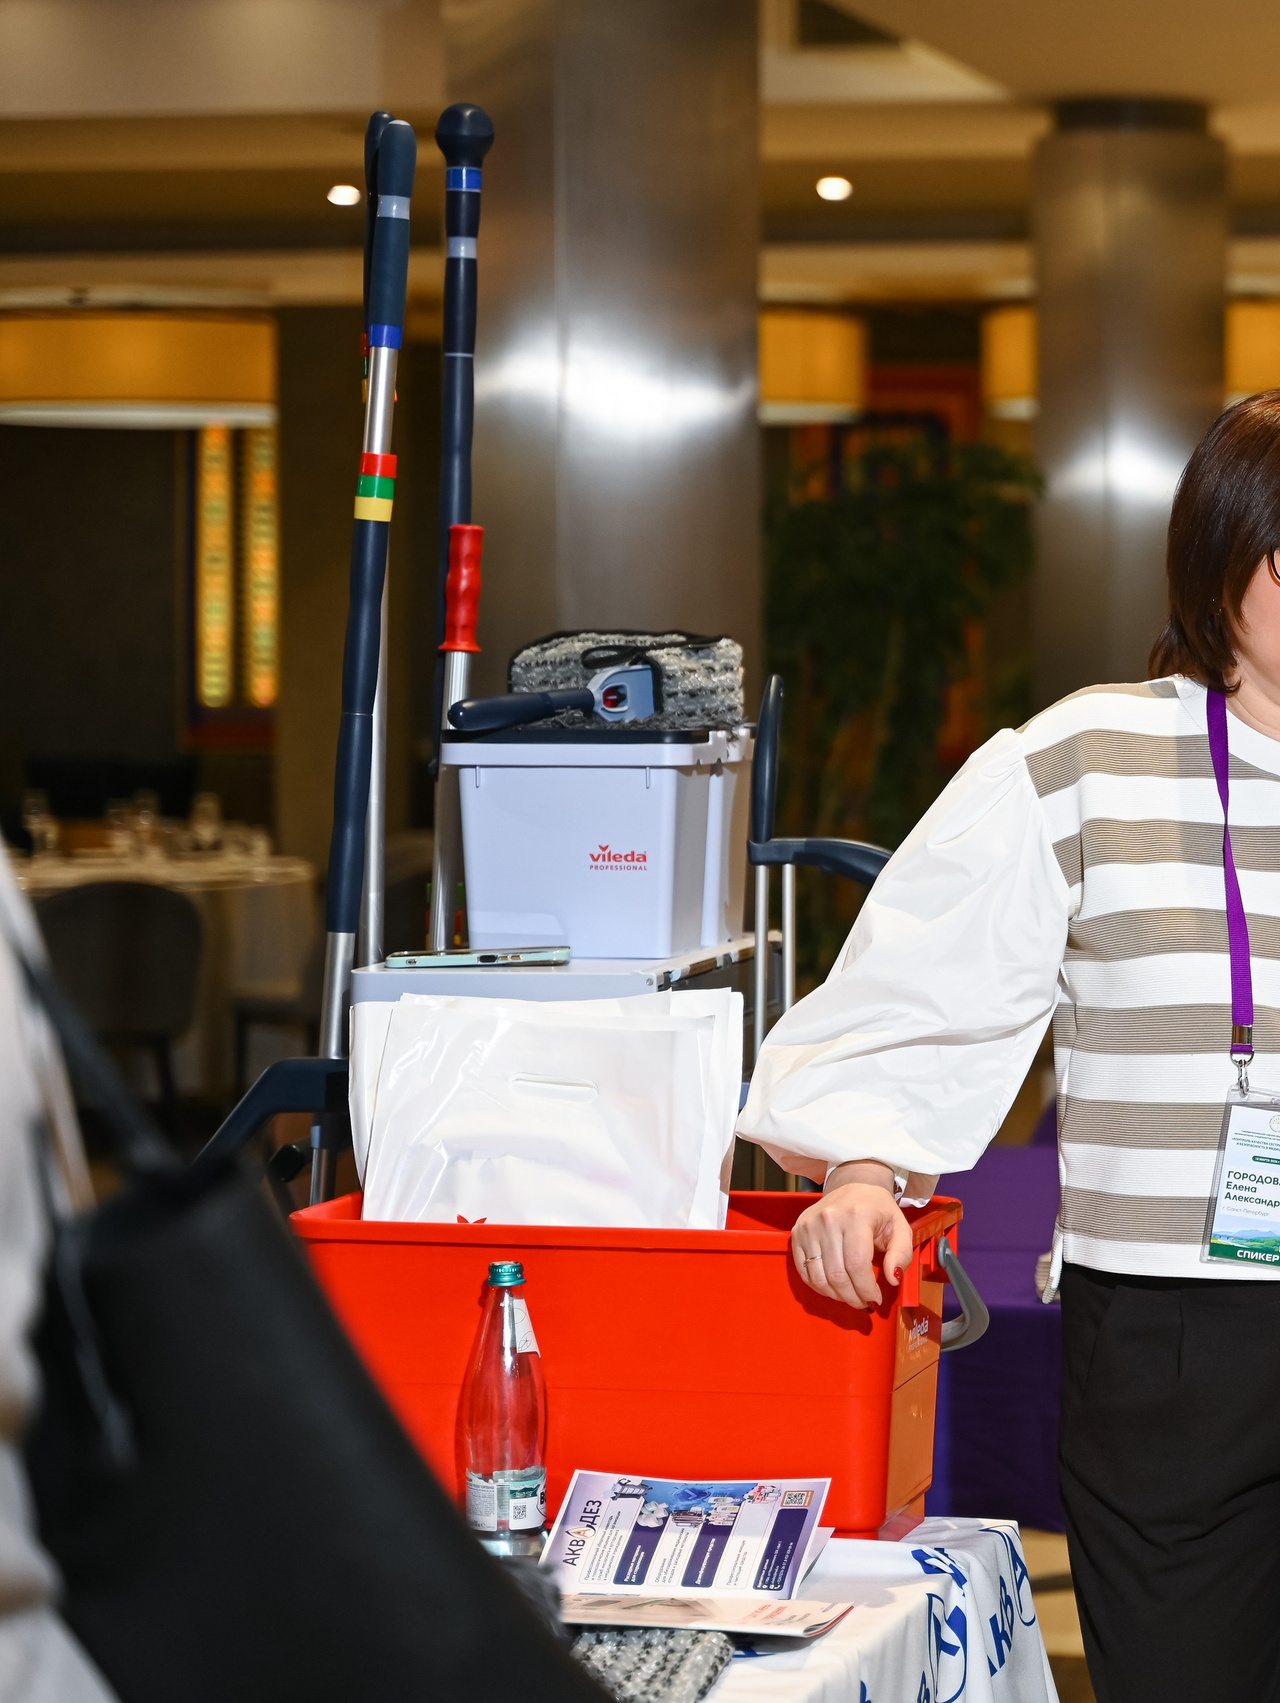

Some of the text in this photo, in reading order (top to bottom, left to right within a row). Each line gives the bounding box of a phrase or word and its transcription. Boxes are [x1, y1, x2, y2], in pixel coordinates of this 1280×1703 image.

[589, 844, 647, 863] vileda
[1226, 1181, 1257, 1192] Елена
[1237, 1249, 1279, 1262] СПИКЕР
[563, 1499, 602, 1566] АКВАДЕЗ
